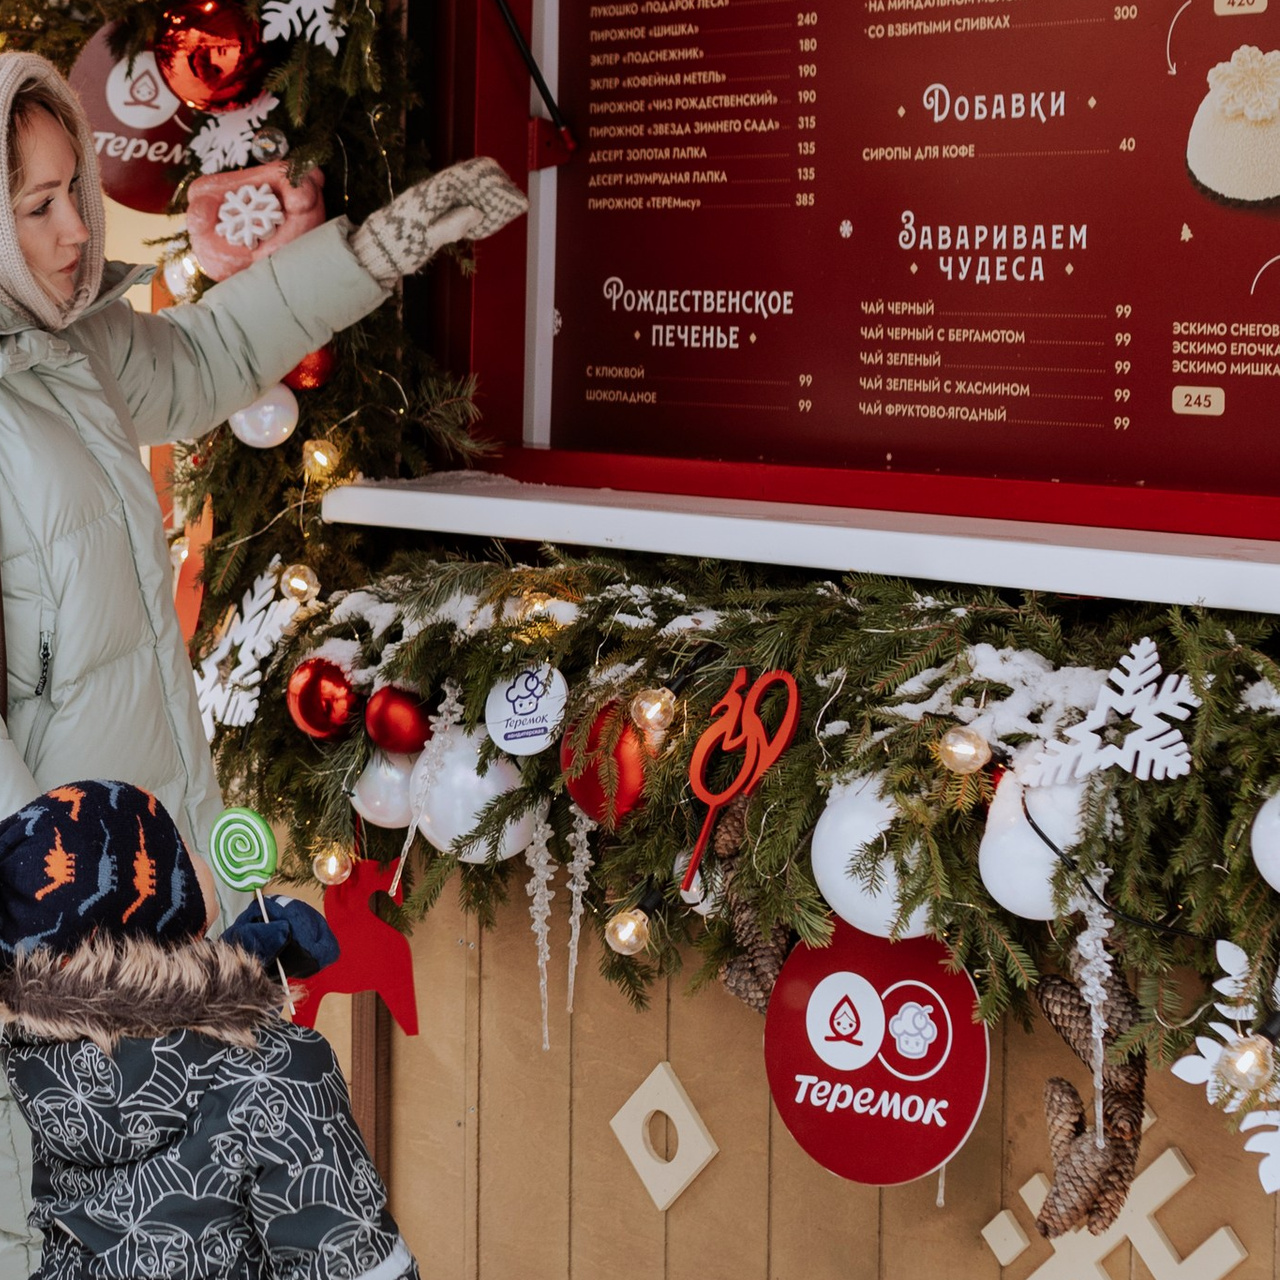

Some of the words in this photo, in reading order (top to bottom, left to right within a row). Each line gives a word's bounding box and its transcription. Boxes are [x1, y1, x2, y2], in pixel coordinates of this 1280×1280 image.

[798, 12, 817, 26] 240
[1114, 5, 1137, 20] 300
[798, 90, 816, 103] 190
[798, 116, 815, 129] 315
[1119, 138, 1135, 151] 40
[798, 167, 815, 180] 135
[796, 193, 814, 206] 385
[1116, 305, 1131, 318] 99
[1115, 333, 1131, 346] 99
[1115, 361, 1130, 374] 99
[799, 374, 812, 386] 99
[1115, 389, 1130, 402] 99
[1184, 393, 1212, 408] 245
[799, 400, 812, 412] 99
[1114, 417, 1130, 430] 99
